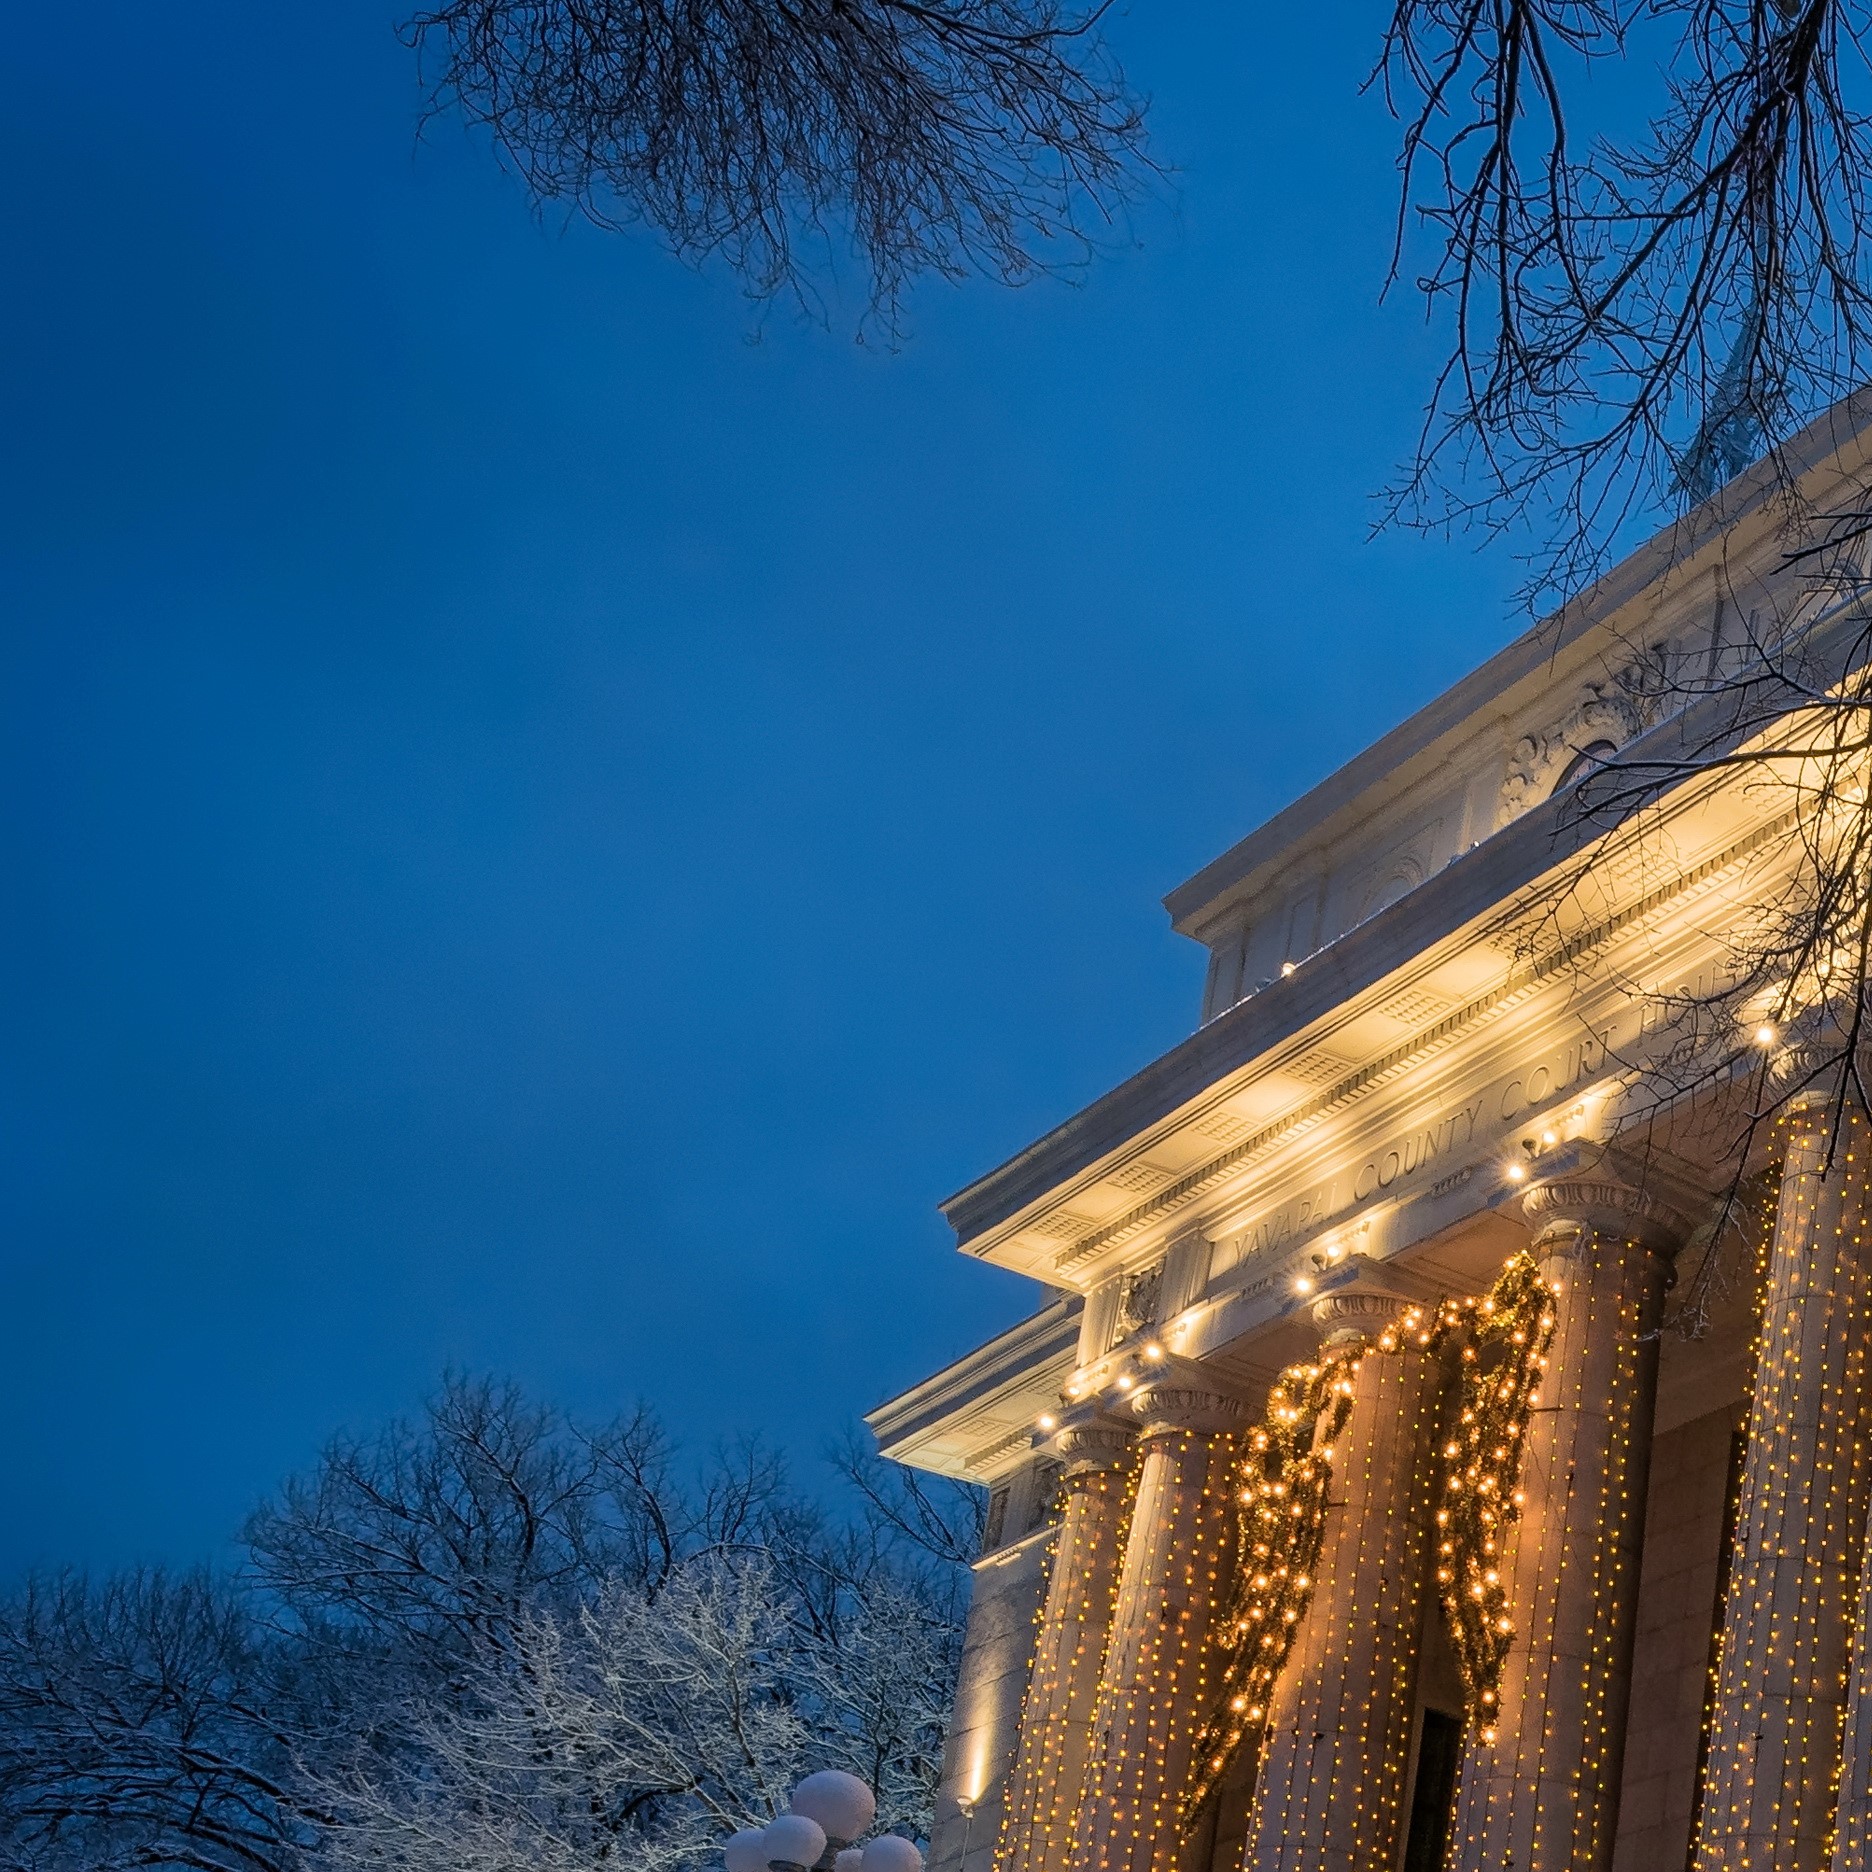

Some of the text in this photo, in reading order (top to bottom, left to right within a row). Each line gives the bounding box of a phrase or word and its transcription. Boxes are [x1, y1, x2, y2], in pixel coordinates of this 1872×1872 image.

[1234, 1182, 1338, 1268] YAVAPAI
[1353, 1100, 1483, 1202] COUNTY
[1500, 1025, 1617, 1121] COURT
